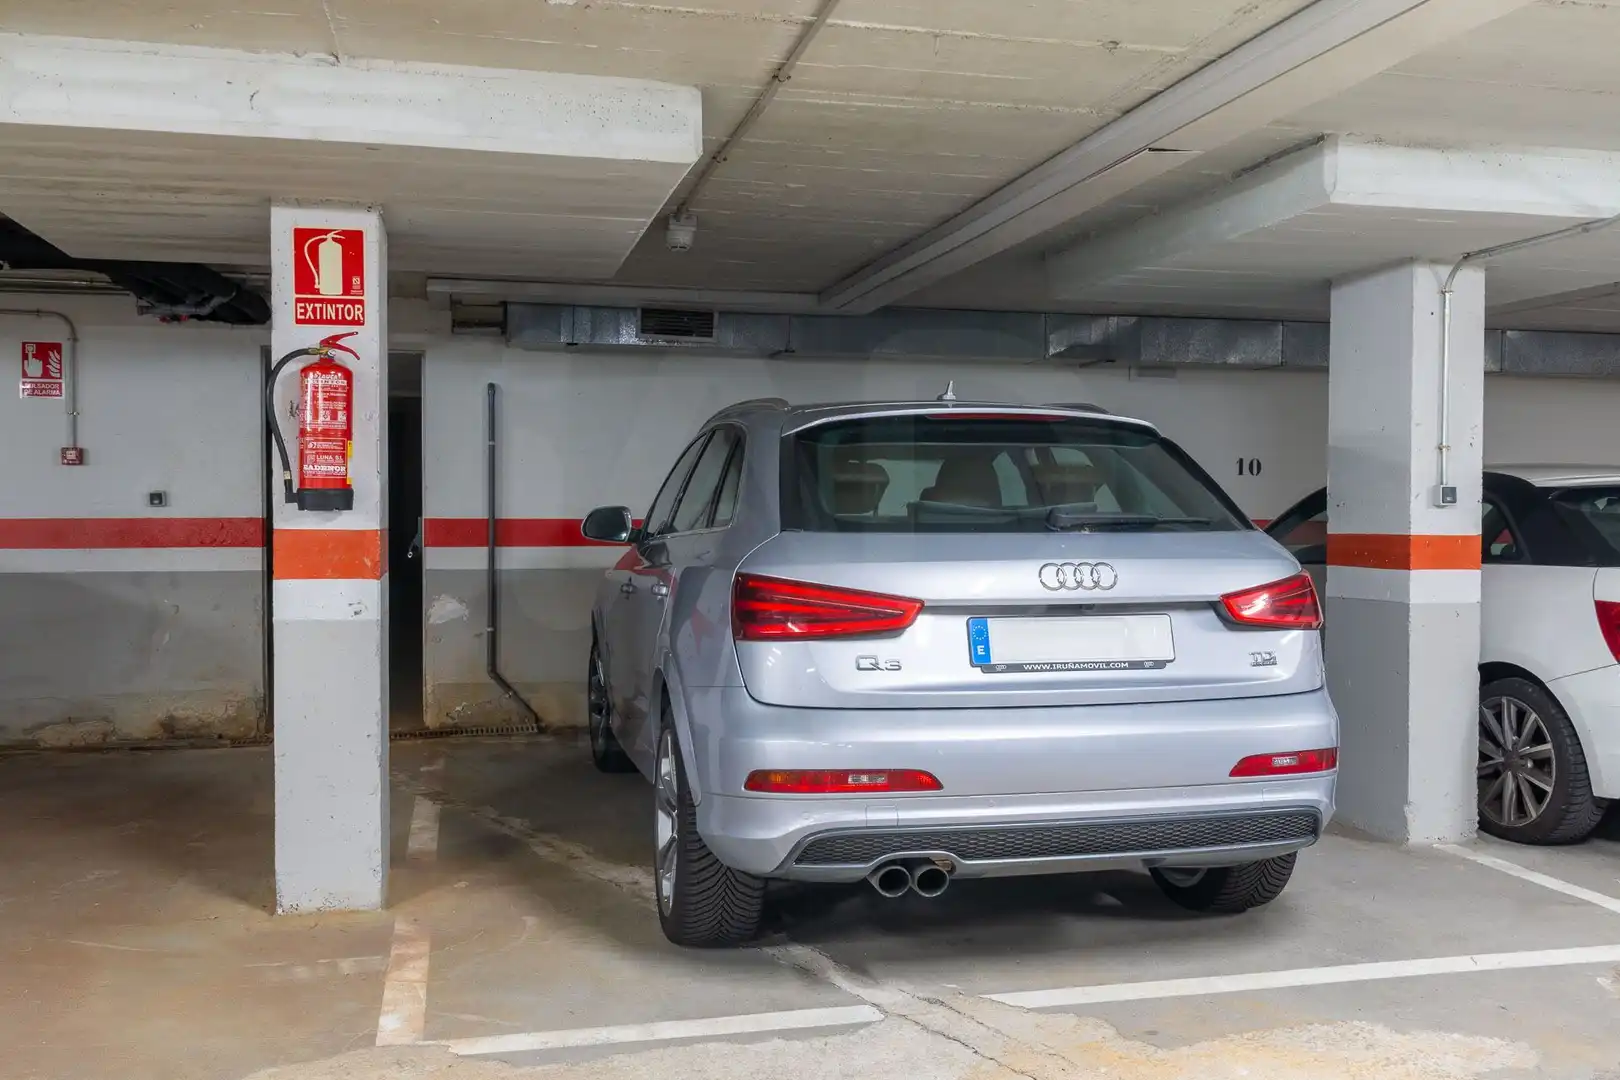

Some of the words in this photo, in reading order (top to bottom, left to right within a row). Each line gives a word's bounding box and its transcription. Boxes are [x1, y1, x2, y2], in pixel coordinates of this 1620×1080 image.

[296, 302, 364, 321] EXTINTOR
[1236, 457, 1262, 476] 10
[977, 645, 986, 656] E
[855, 654, 902, 671] Q3
[1023, 662, 1129, 671] WWW.IRUÑAMOVIL.COM
